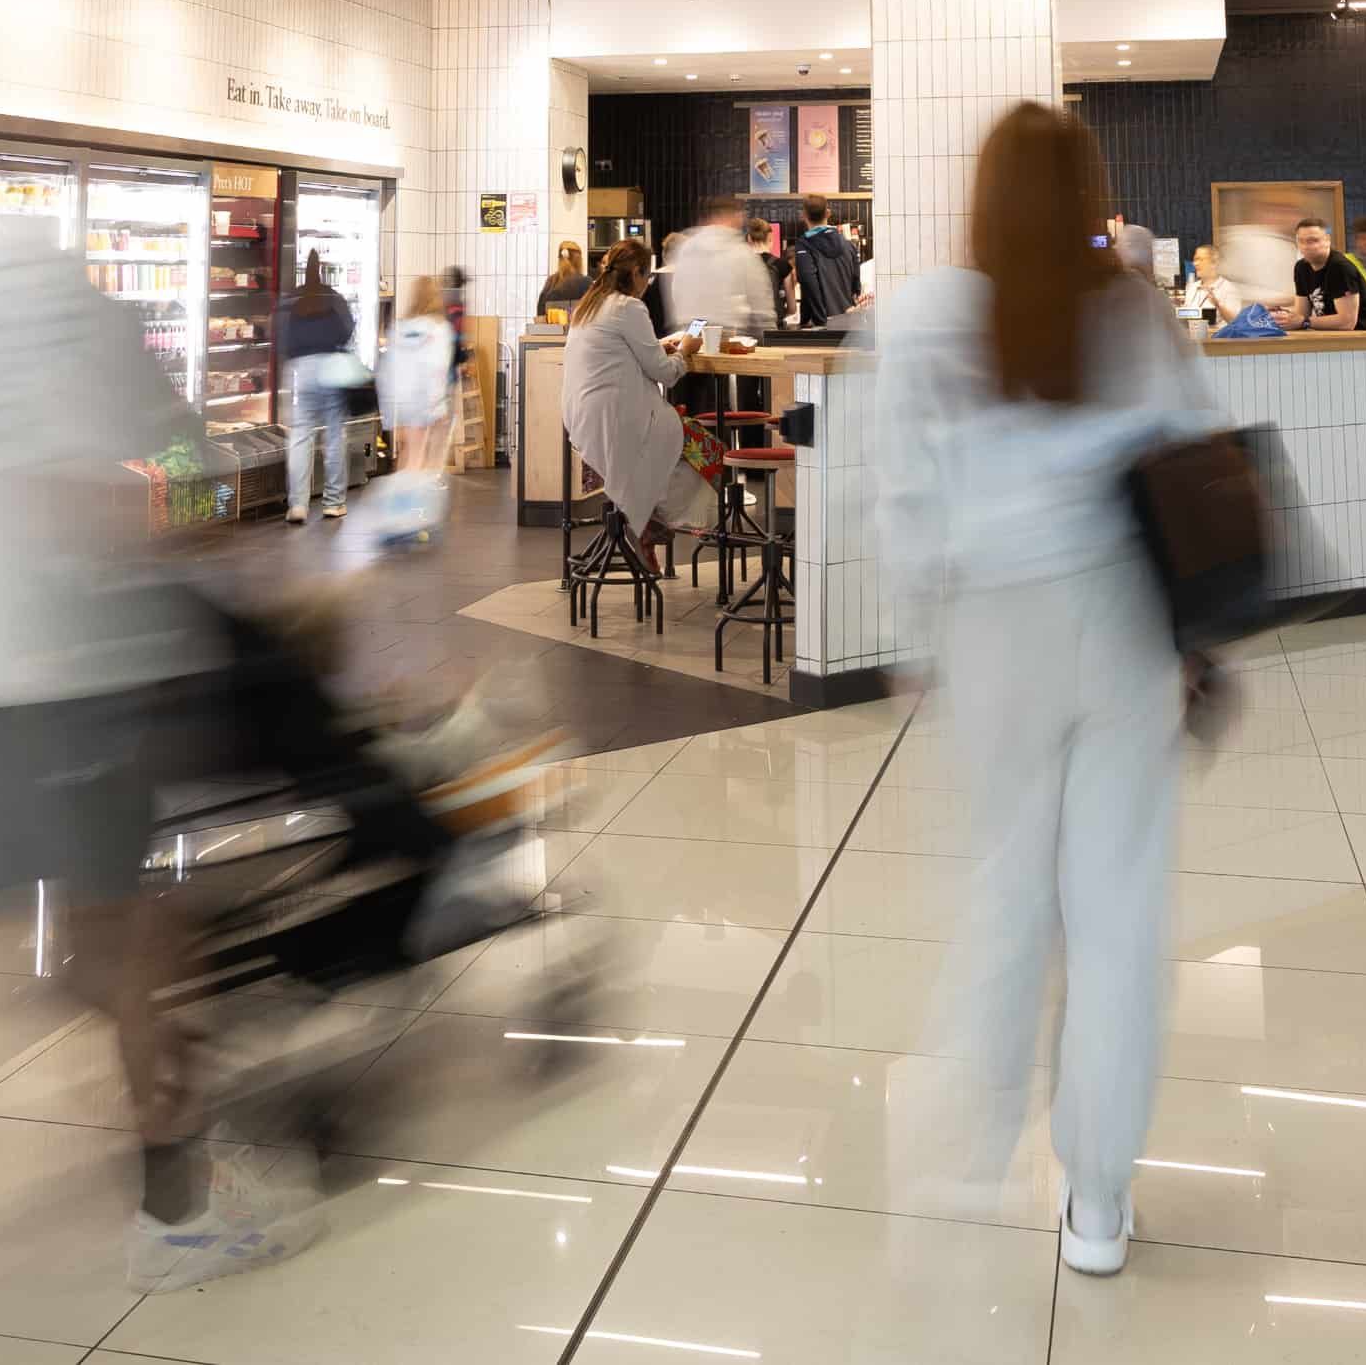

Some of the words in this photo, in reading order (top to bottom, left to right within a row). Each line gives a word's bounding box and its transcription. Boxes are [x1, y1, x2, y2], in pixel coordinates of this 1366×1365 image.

[227, 77, 246, 103] Eat
[249, 82, 264, 107] in.
[265, 84, 292, 112] Take
[294, 98, 322, 122] away.
[324, 97, 348, 121] Take
[349, 109, 360, 125] on
[363, 104, 391, 130] board.
